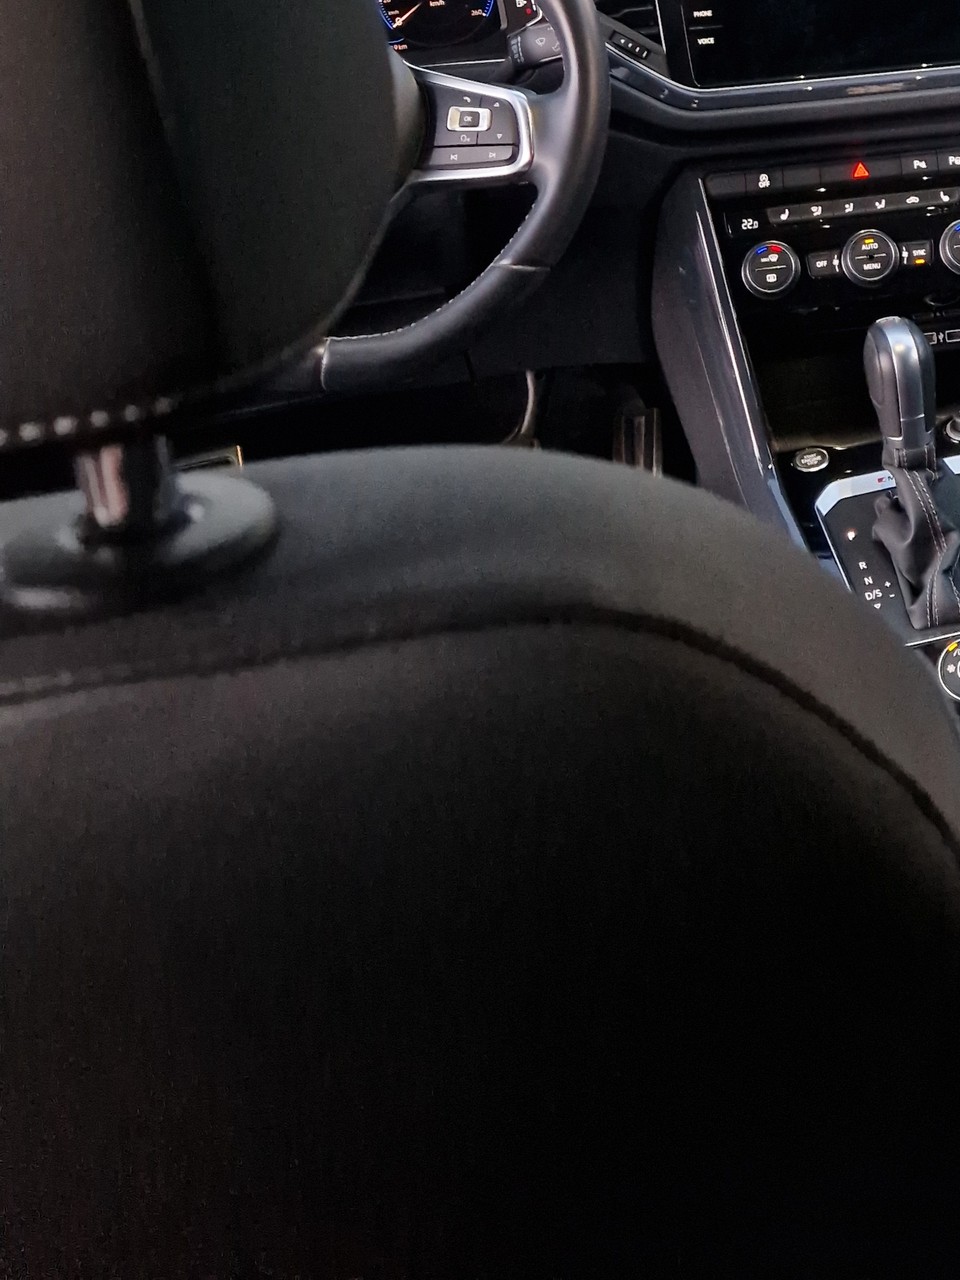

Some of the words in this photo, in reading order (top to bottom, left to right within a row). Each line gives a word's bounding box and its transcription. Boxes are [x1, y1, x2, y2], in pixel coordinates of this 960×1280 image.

[758, 180, 771, 188] OFF
[858, 561, 867, 570] R
[863, 576, 873, 585] N
[864, 589, 883, 601] D/S
